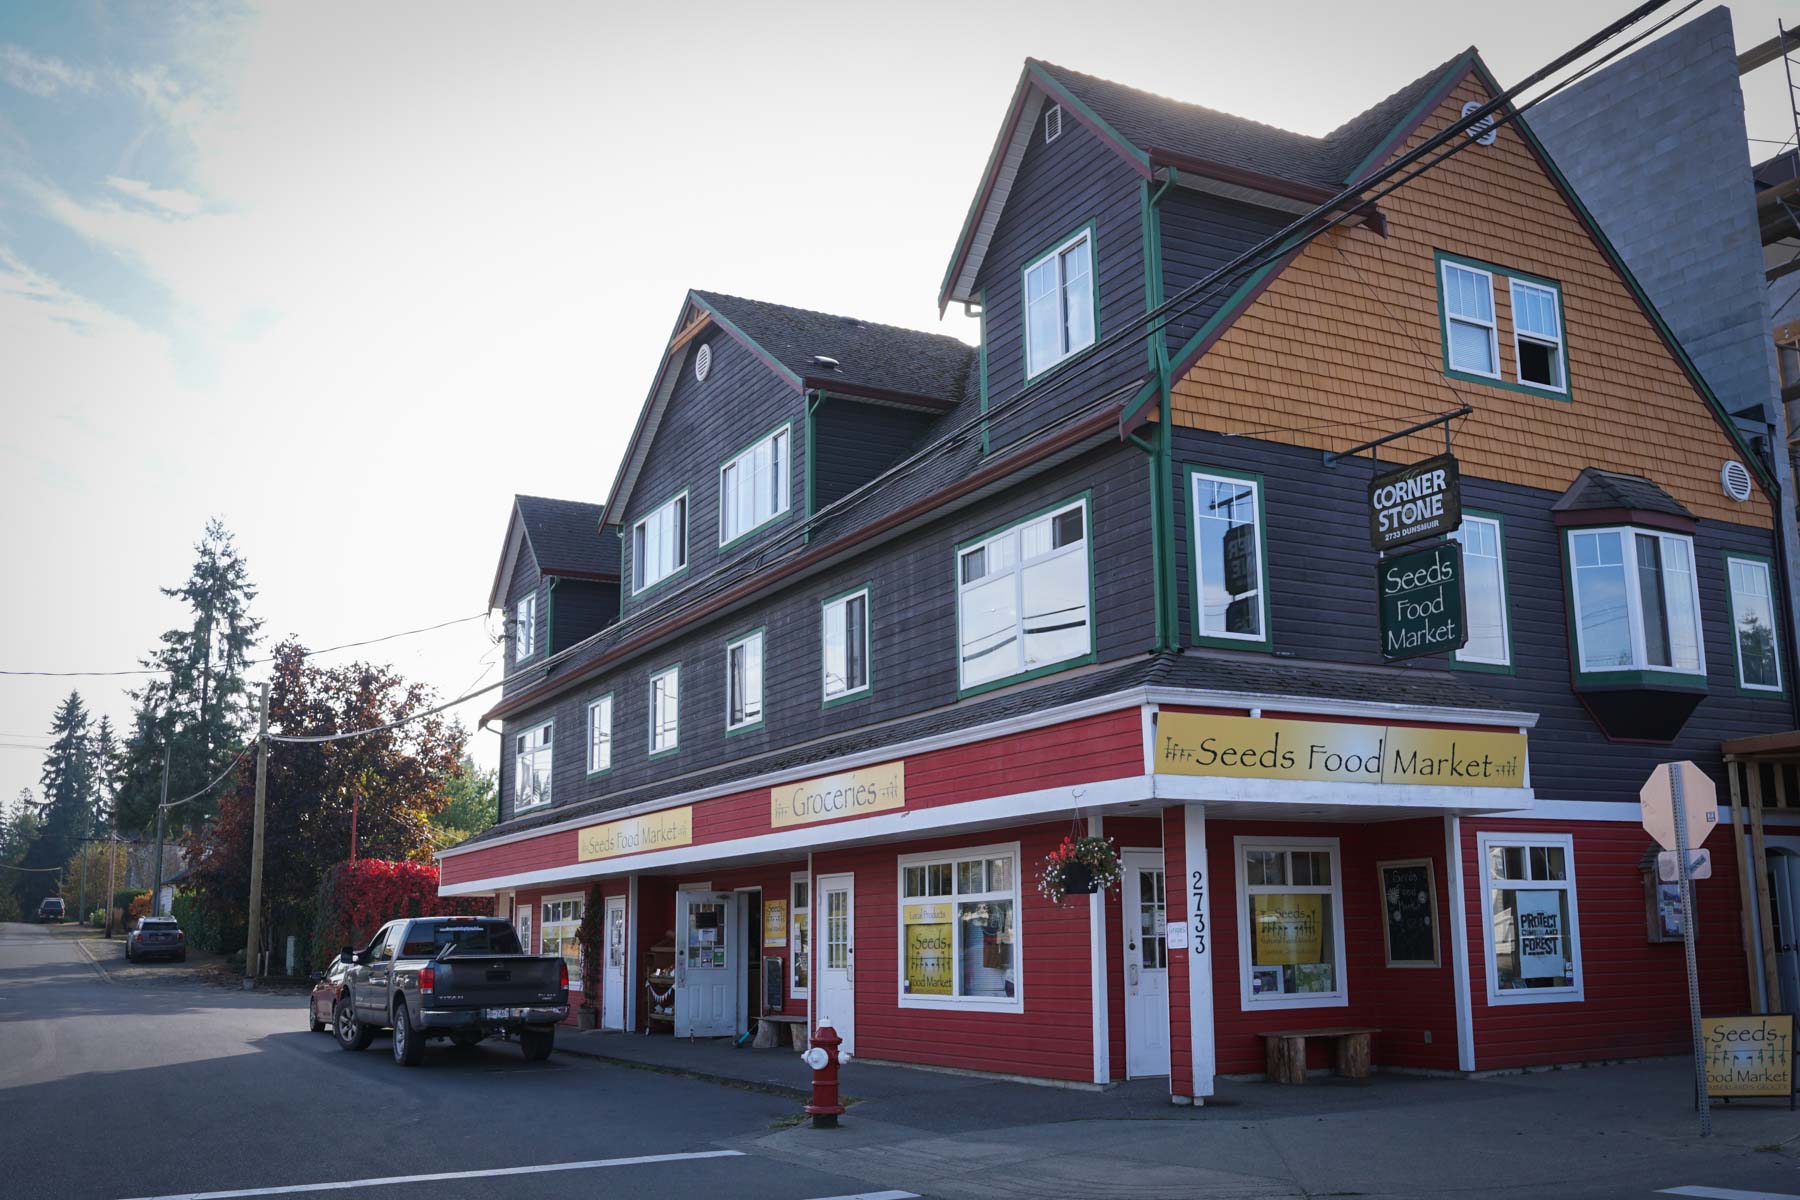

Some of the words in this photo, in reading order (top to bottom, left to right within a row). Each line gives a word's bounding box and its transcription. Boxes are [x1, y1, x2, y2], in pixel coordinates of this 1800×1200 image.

[1373, 469, 1447, 510] CORNER
[1379, 493, 1444, 532] STONE
[1385, 530, 1401, 541] 2733
[1402, 520, 1440, 537] DUNSMUIR
[1385, 551, 1453, 594] Seeds
[1397, 586, 1444, 621] Food
[1388, 618, 1456, 651] Market
[1196, 731, 1295, 770] Seeds
[1308, 738, 1383, 774] Food
[1393, 742, 1493, 778] Market
[792, 774, 877, 817] Groceries
[588, 827, 615, 854] Seeds
[617, 821, 640, 849] Food
[642, 816, 677, 845] Market
[1192, 870, 1206, 955] 2733
[1275, 904, 1306, 920] Seeds
[1520, 912, 1557, 929] PROTECT
[914, 928, 947, 950] Seeds
[1522, 937, 1558, 956] FOREST
[1711, 1020, 1778, 1043] Seeds
[1706, 1067, 1733, 1083] ood
[1737, 1067, 1789, 1083] Market
